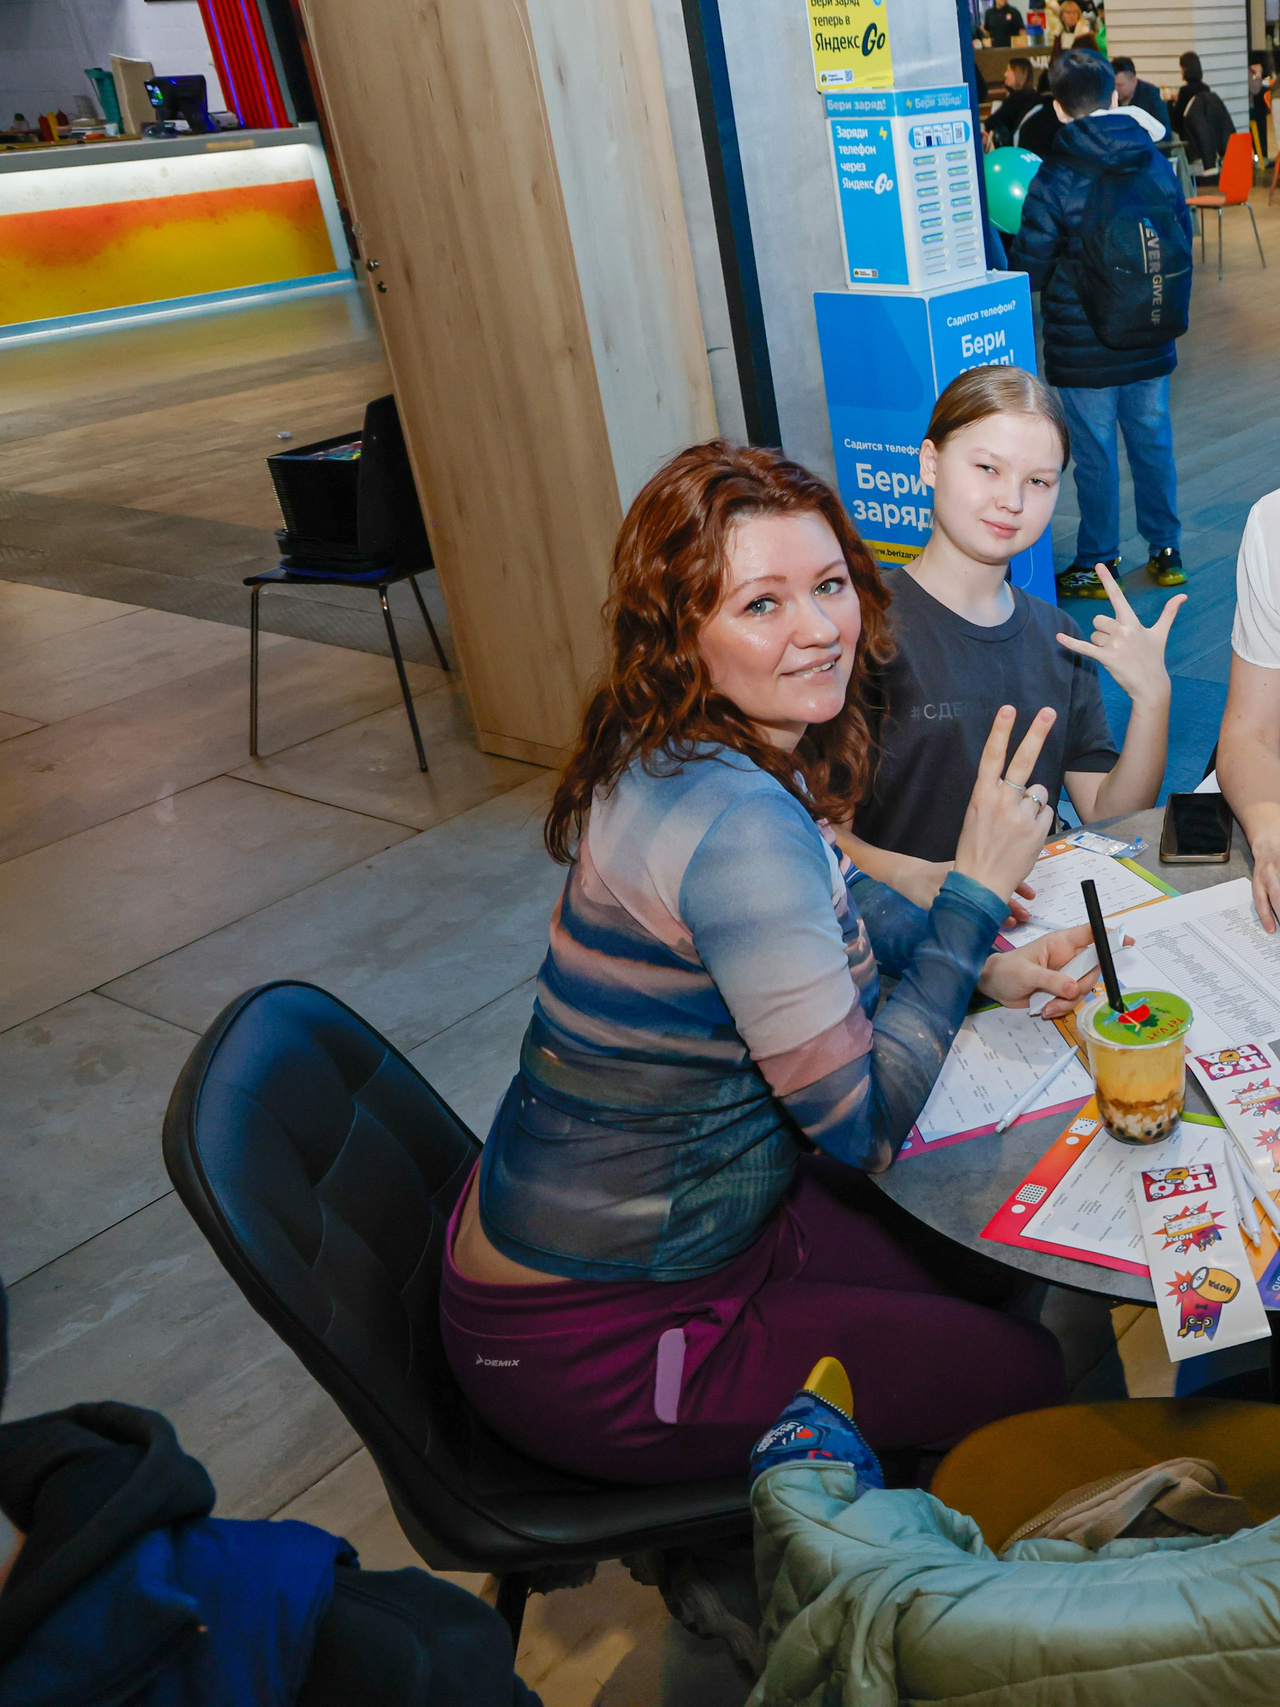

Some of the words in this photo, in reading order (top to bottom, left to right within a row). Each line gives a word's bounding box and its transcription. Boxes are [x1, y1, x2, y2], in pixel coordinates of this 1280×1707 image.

[813, 16, 843, 28] теперь
[845, 15, 850, 25] в
[815, 32, 860, 53] Яндекс
[861, 22, 886, 56] Go
[827, 99, 852, 111] Бери
[854, 98, 886, 111] заряд!
[915, 98, 936, 109] Бери
[835, 126, 868, 140] Заряди
[838, 143, 876, 157] телефон
[840, 162, 866, 173] через
[842, 177, 874, 191] Яндекс
[874, 173, 893, 195] Go
[1152, 274, 1163, 306] GIVE
[946, 312, 979, 328] Садится
[980, 300, 1016, 320] телефон?
[961, 329, 1006, 358] Бери
[844, 438, 883, 452] Садится
[885, 444, 920, 457] телефо
[855, 462, 928, 499] Бери
[853, 499, 934, 532] заряд
[484, 1358, 520, 1368] DEMIX
